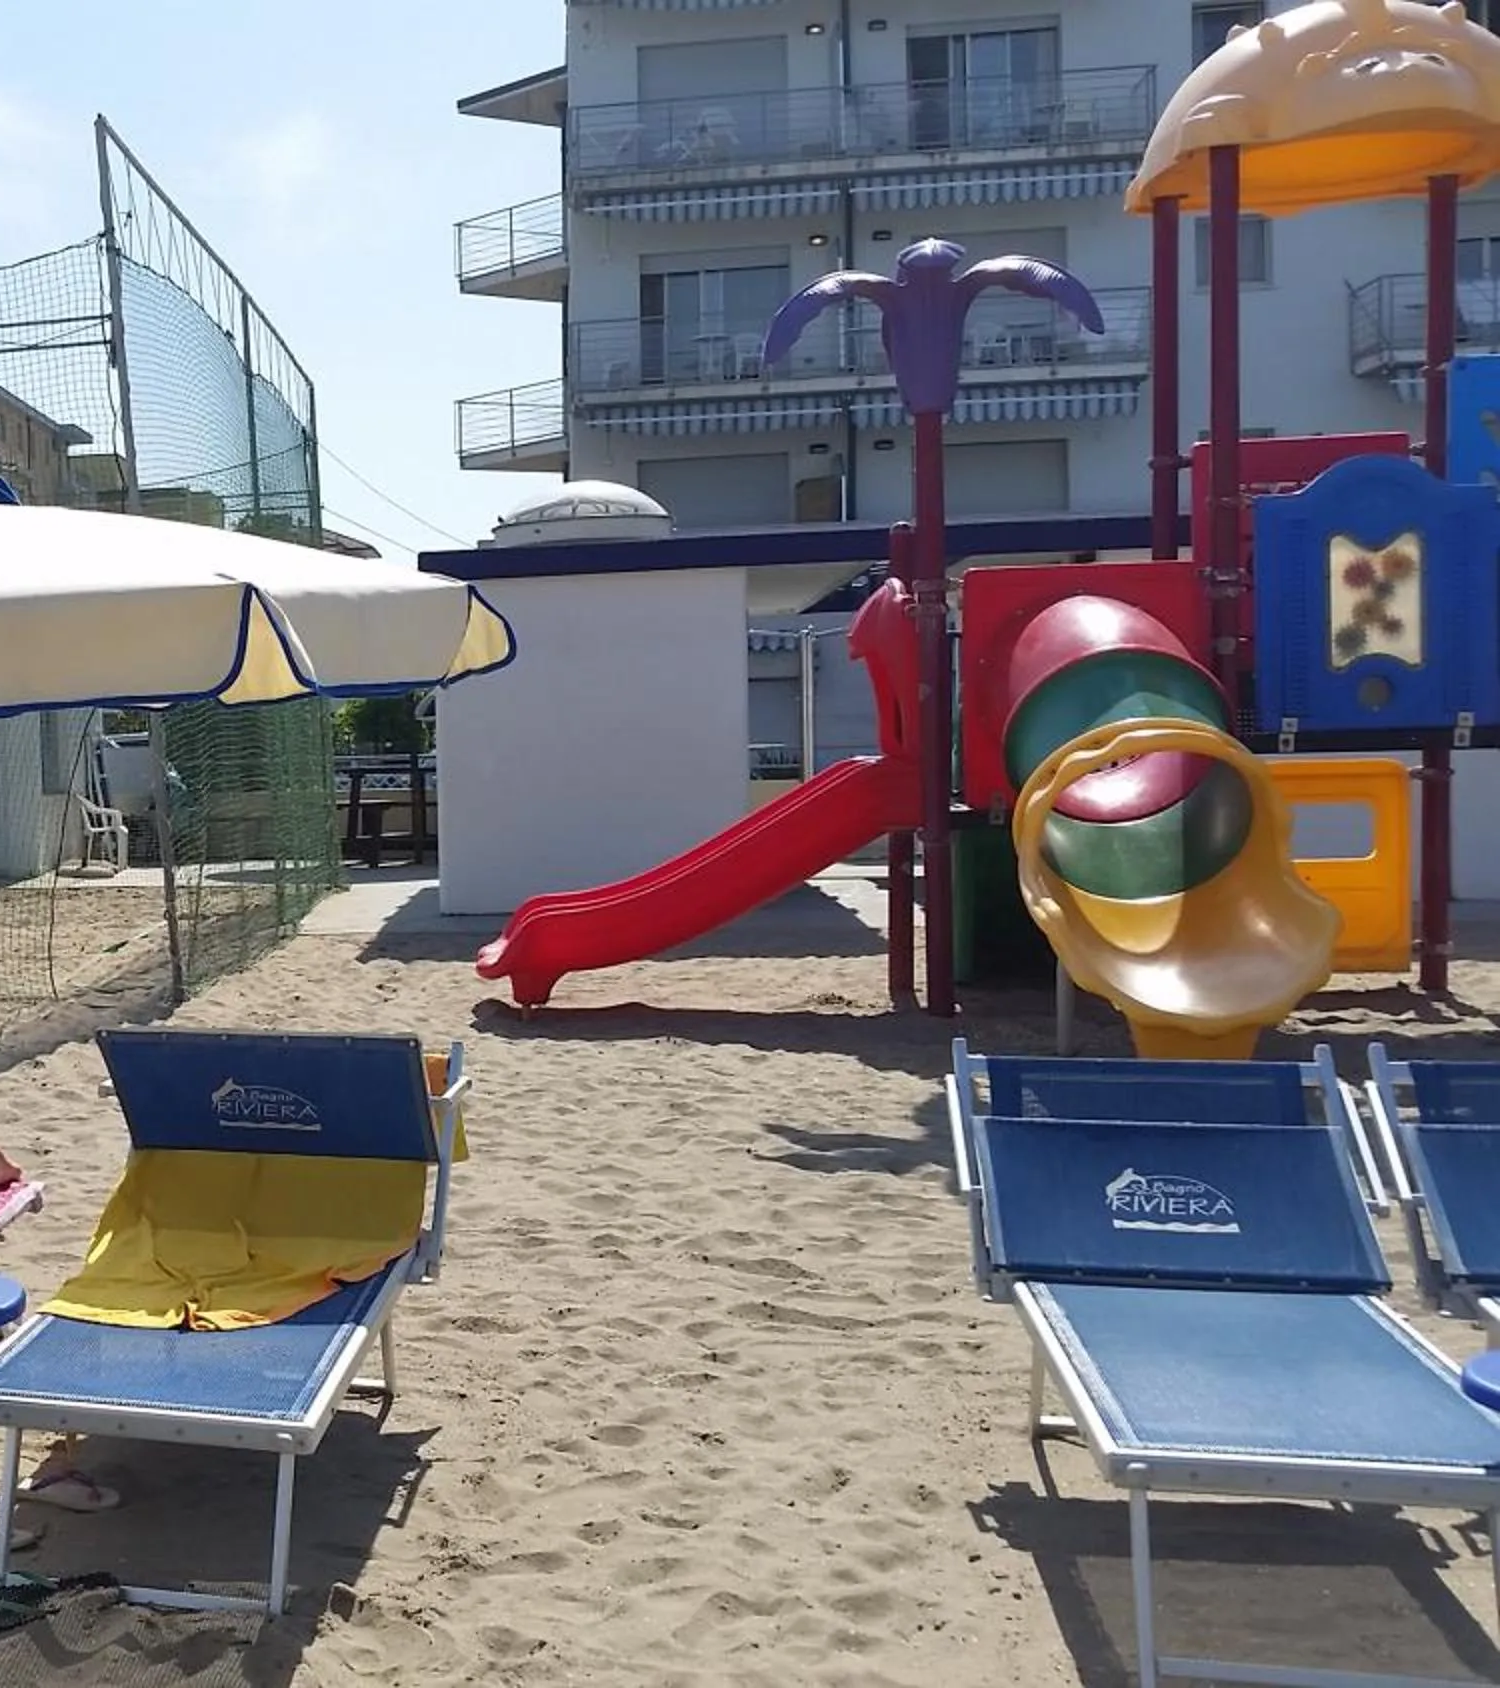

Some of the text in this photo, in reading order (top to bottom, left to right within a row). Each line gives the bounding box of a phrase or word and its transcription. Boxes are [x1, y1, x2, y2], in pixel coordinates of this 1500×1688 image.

[217, 1099, 318, 1119] RIVIERA
[1152, 1181, 1205, 1196] Bagno
[1111, 1194, 1234, 1216] RIVIERA
